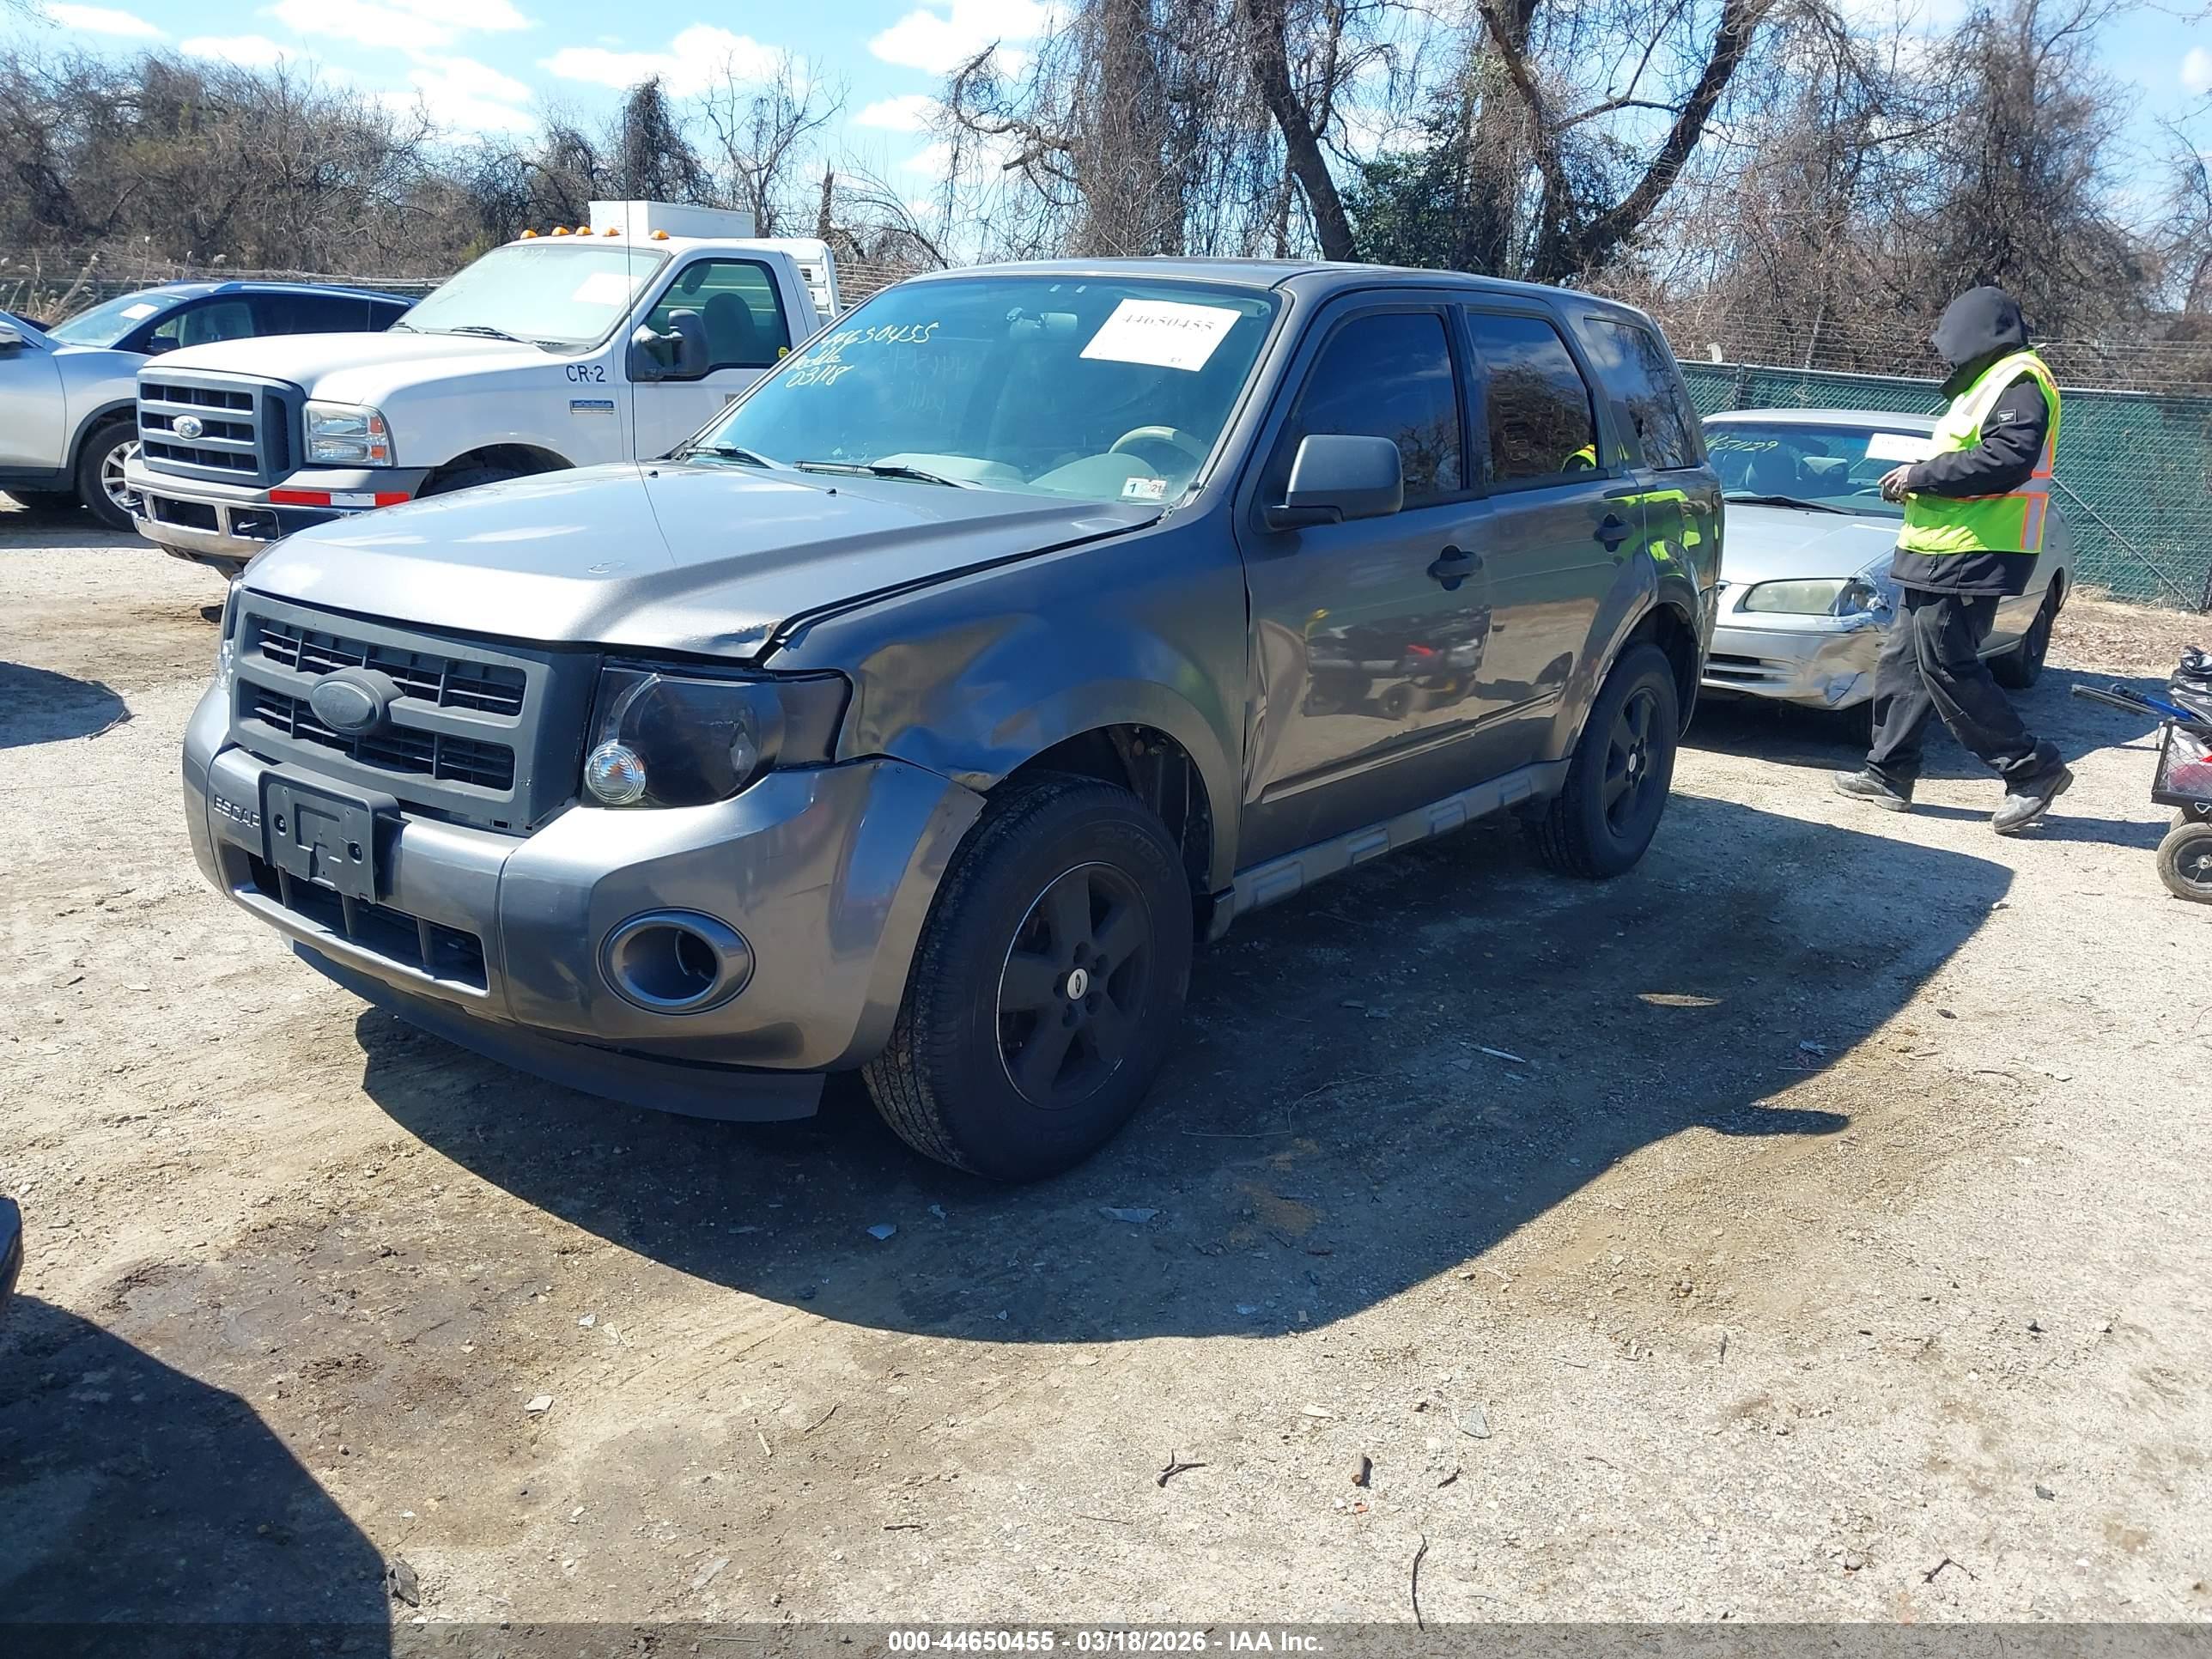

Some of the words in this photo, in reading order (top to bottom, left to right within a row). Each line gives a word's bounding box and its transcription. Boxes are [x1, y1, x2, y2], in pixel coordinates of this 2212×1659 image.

[566, 365, 606, 383] CR-2
[786, 365, 854, 387] 03/18
[1129, 483, 1137, 493] 1
[214, 794, 260, 828] ESCAP
